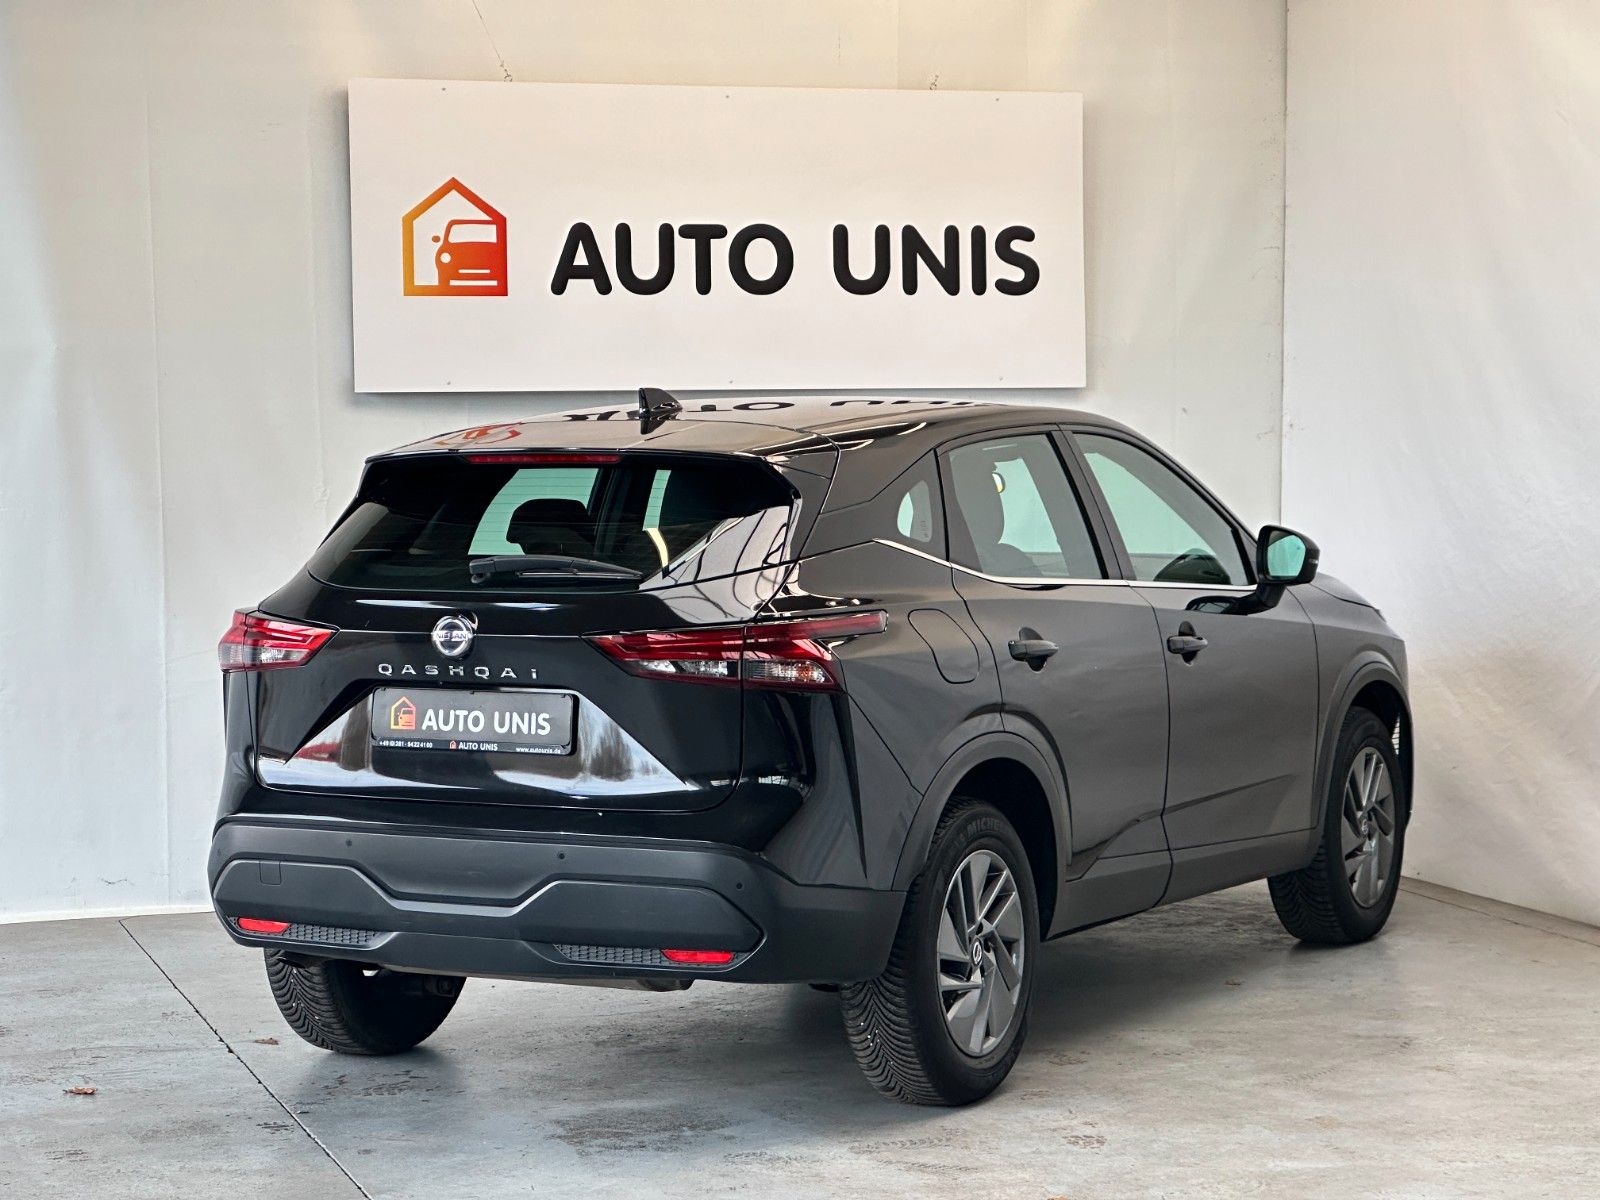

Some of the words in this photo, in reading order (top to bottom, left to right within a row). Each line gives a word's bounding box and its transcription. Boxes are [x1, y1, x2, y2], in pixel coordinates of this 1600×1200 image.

[551, 221, 794, 296] AUTO
[833, 223, 1041, 297] UNIS
[422, 708, 485, 733] AUTO
[494, 711, 551, 736] UNIS
[458, 742, 478, 751] AUTO
[480, 743, 498, 752] UNIS
